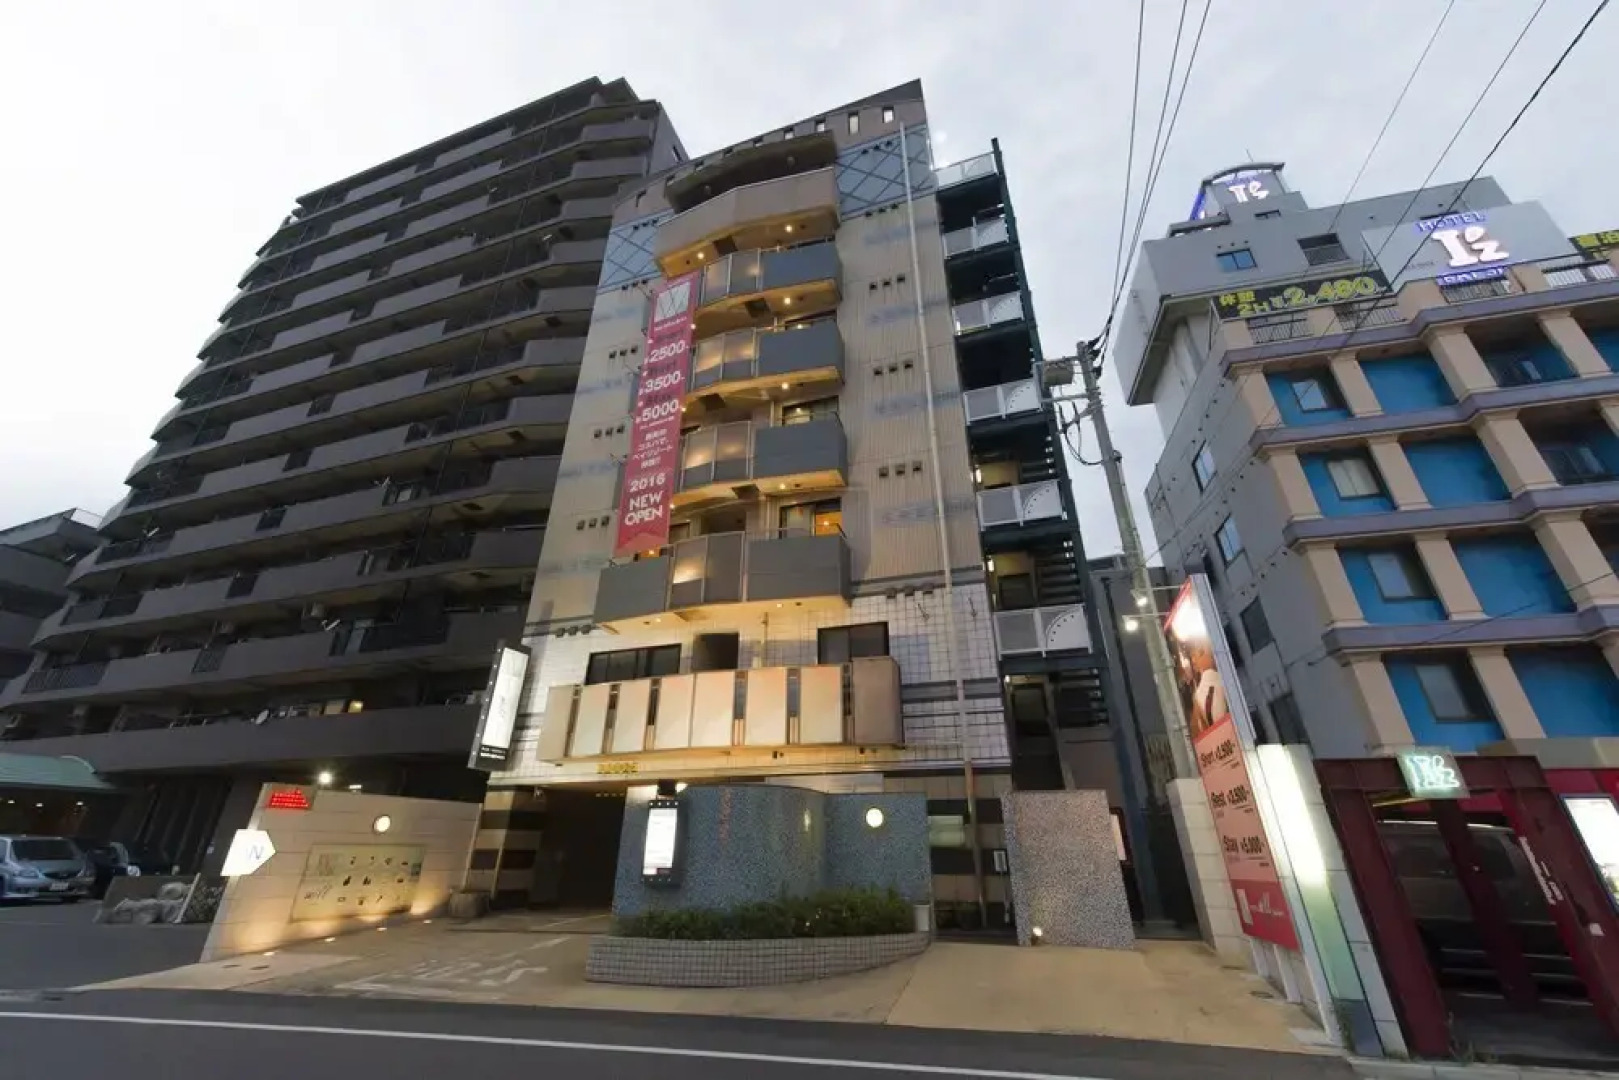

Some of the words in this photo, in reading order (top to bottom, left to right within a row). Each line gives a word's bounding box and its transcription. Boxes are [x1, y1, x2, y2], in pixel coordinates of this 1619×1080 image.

[1415, 211, 1486, 233] HOTEL
[629, 472, 666, 493] 2016
[629, 490, 664, 511] NEW
[624, 505, 663, 526] OPEN
